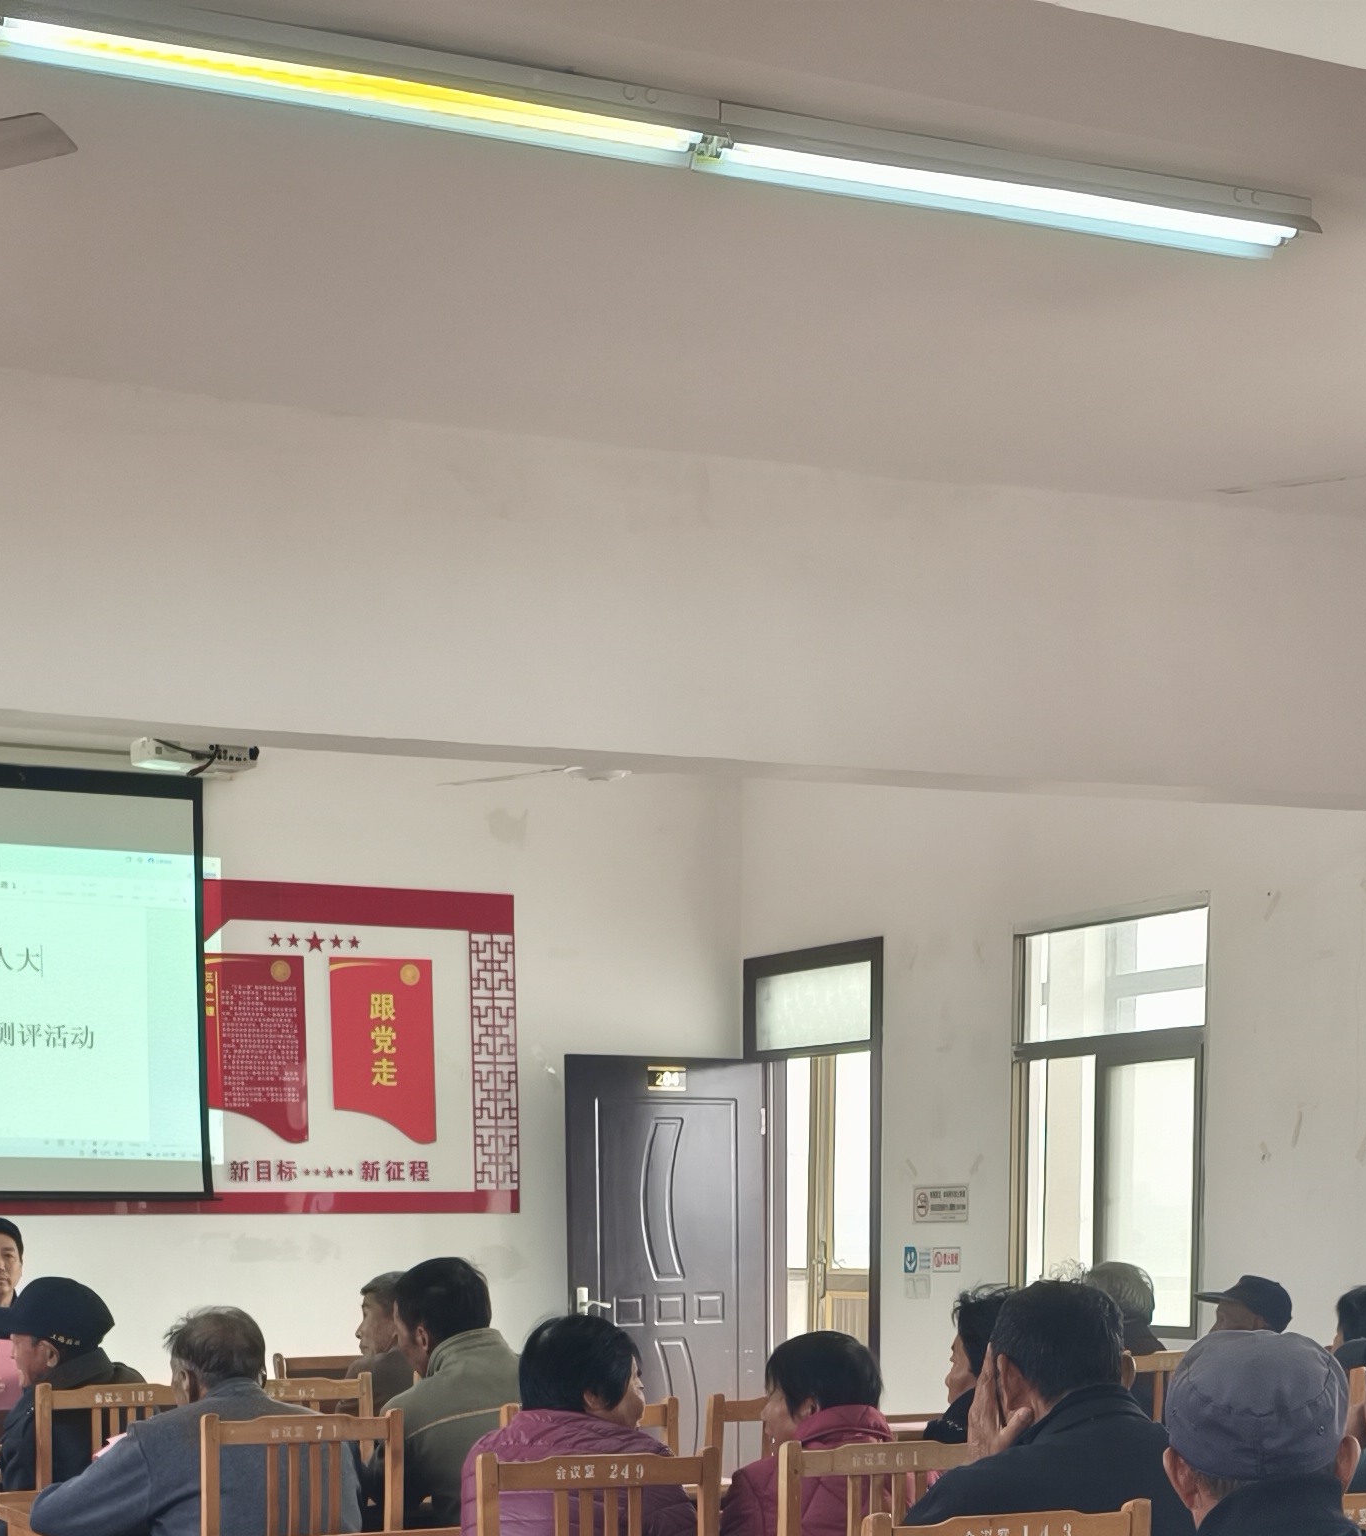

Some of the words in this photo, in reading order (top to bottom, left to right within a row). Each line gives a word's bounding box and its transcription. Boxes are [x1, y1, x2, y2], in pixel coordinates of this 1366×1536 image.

[370, 993, 397, 1087] 跟党走
[229, 1159, 298, 1182] 新目标
[360, 1159, 430, 1182] 新征程
[556, 1464, 595, 1480] 会议室
[609, 1463, 645, 1479] 249
